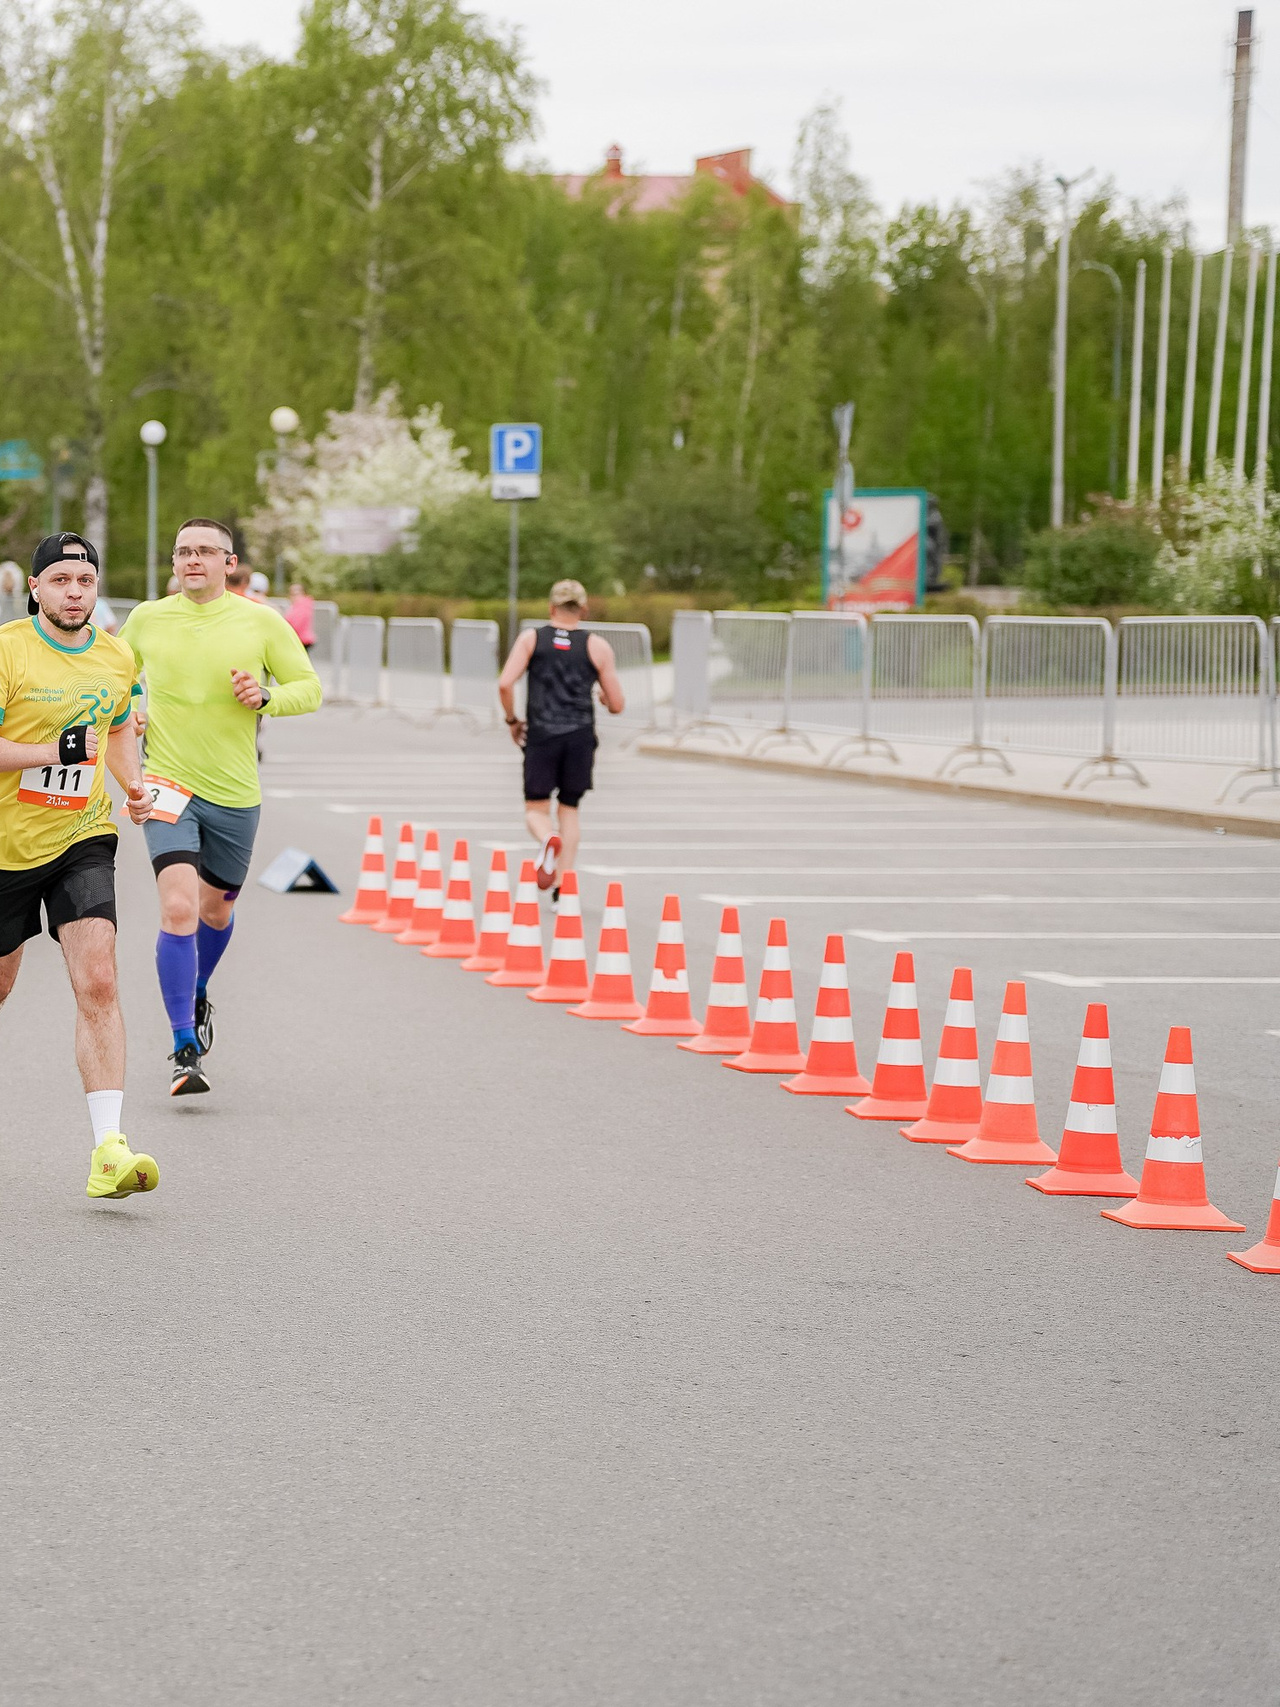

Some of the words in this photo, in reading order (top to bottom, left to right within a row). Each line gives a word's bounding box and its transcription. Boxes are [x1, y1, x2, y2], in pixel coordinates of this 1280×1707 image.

[503, 430, 533, 471] P
[30, 686, 65, 695] зелёный
[24, 695, 62, 704] марафон
[41, 766, 81, 791] 111
